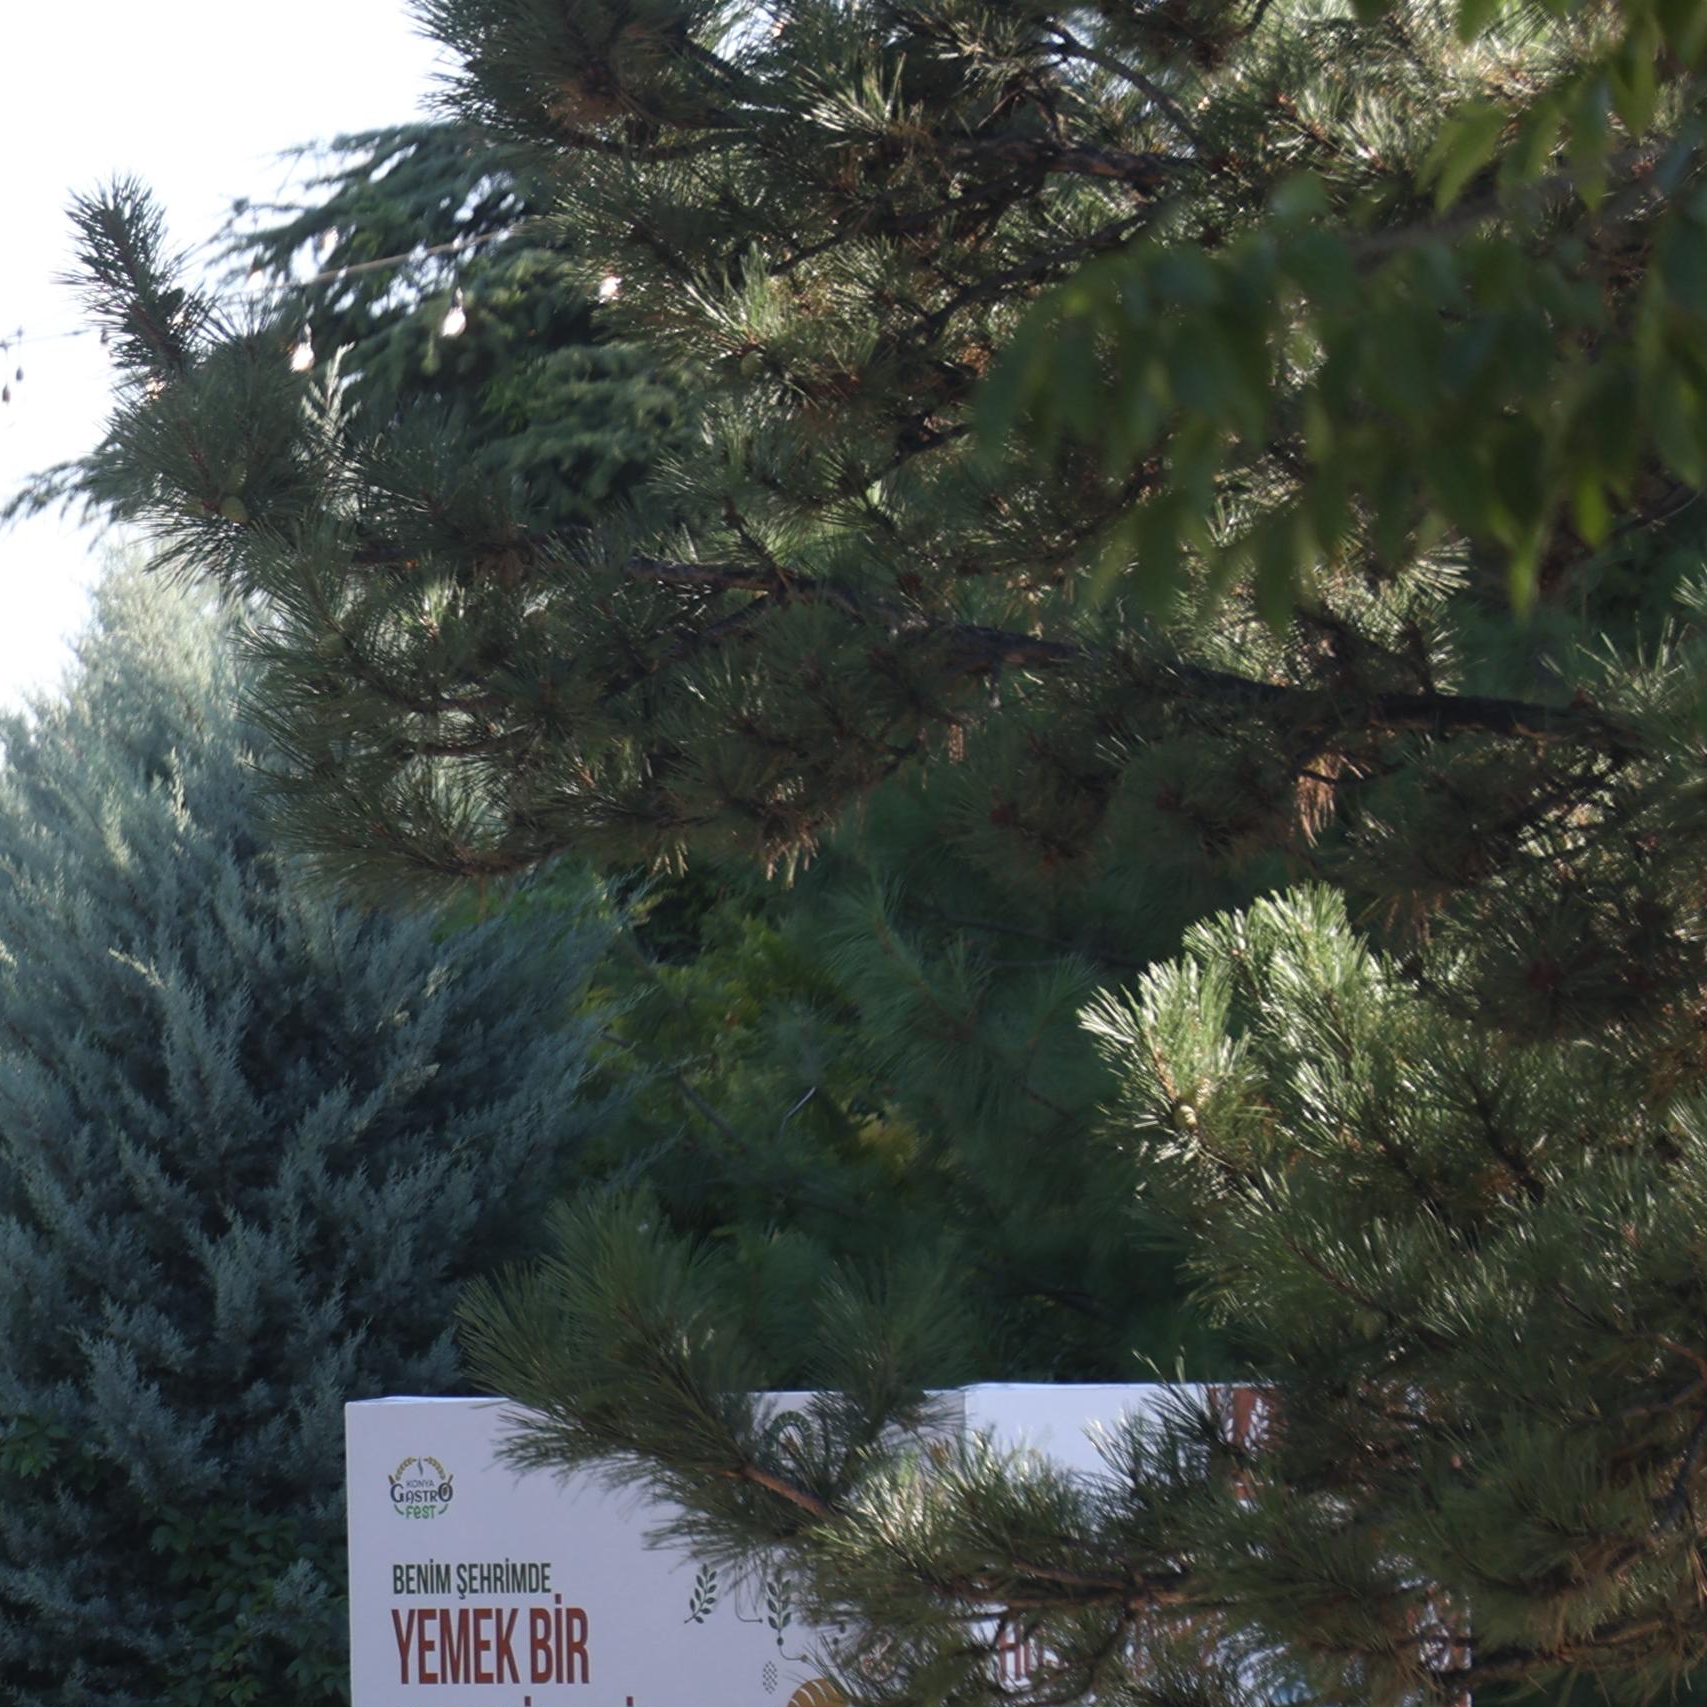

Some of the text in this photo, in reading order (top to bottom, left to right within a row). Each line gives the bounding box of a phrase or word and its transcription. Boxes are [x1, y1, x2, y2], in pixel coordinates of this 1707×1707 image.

[393, 1557, 551, 1600] BENİM ŞEHRİMDE
[391, 1593, 590, 1685] YEMEK BİR
